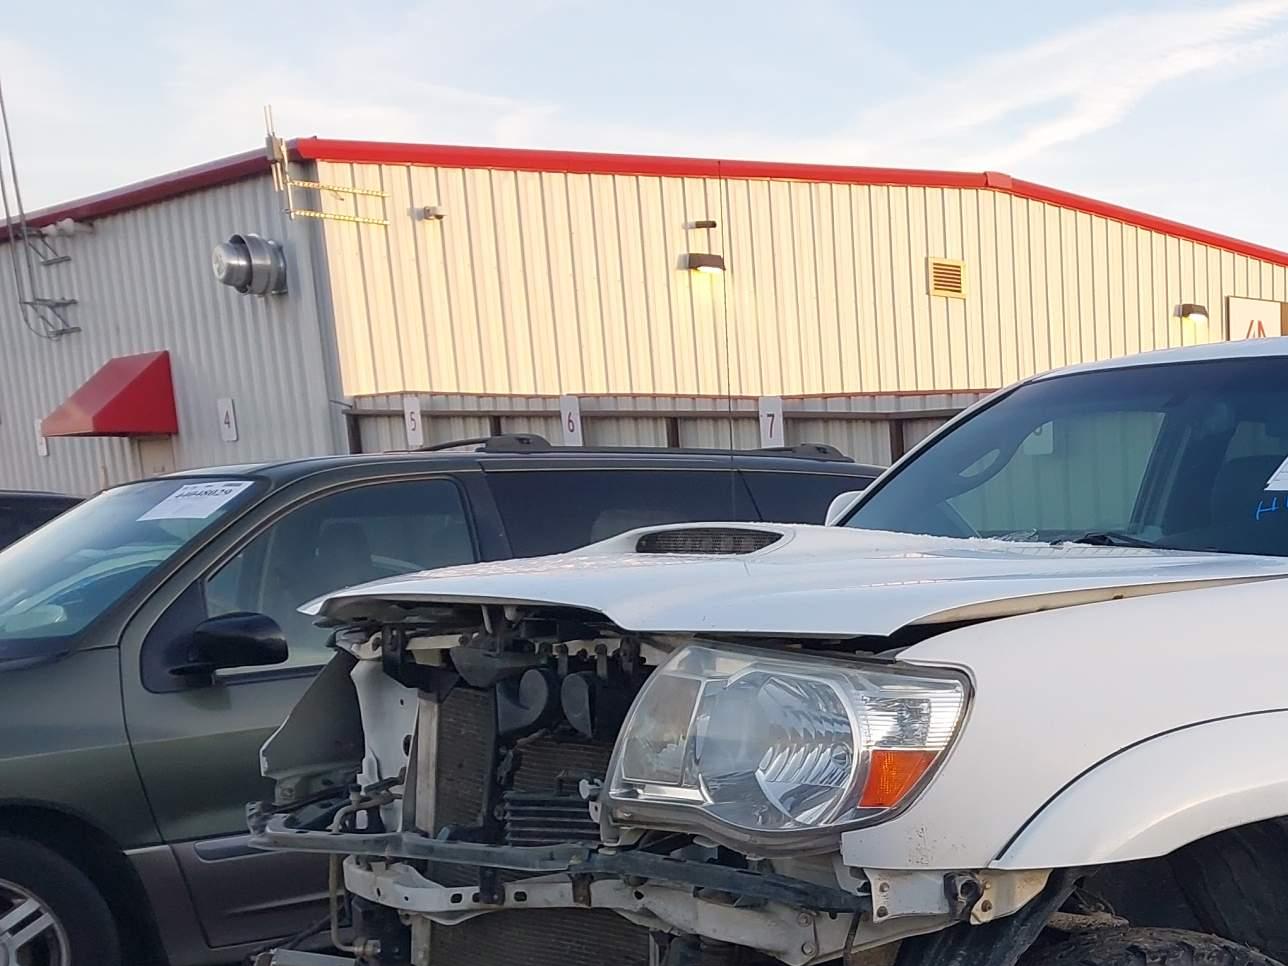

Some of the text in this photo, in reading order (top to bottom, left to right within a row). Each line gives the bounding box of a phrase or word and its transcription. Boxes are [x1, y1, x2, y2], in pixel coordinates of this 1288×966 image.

[223, 410, 231, 429] 4
[410, 411, 417, 432] 5
[567, 411, 575, 433] 6
[766, 413, 775, 439] 7
